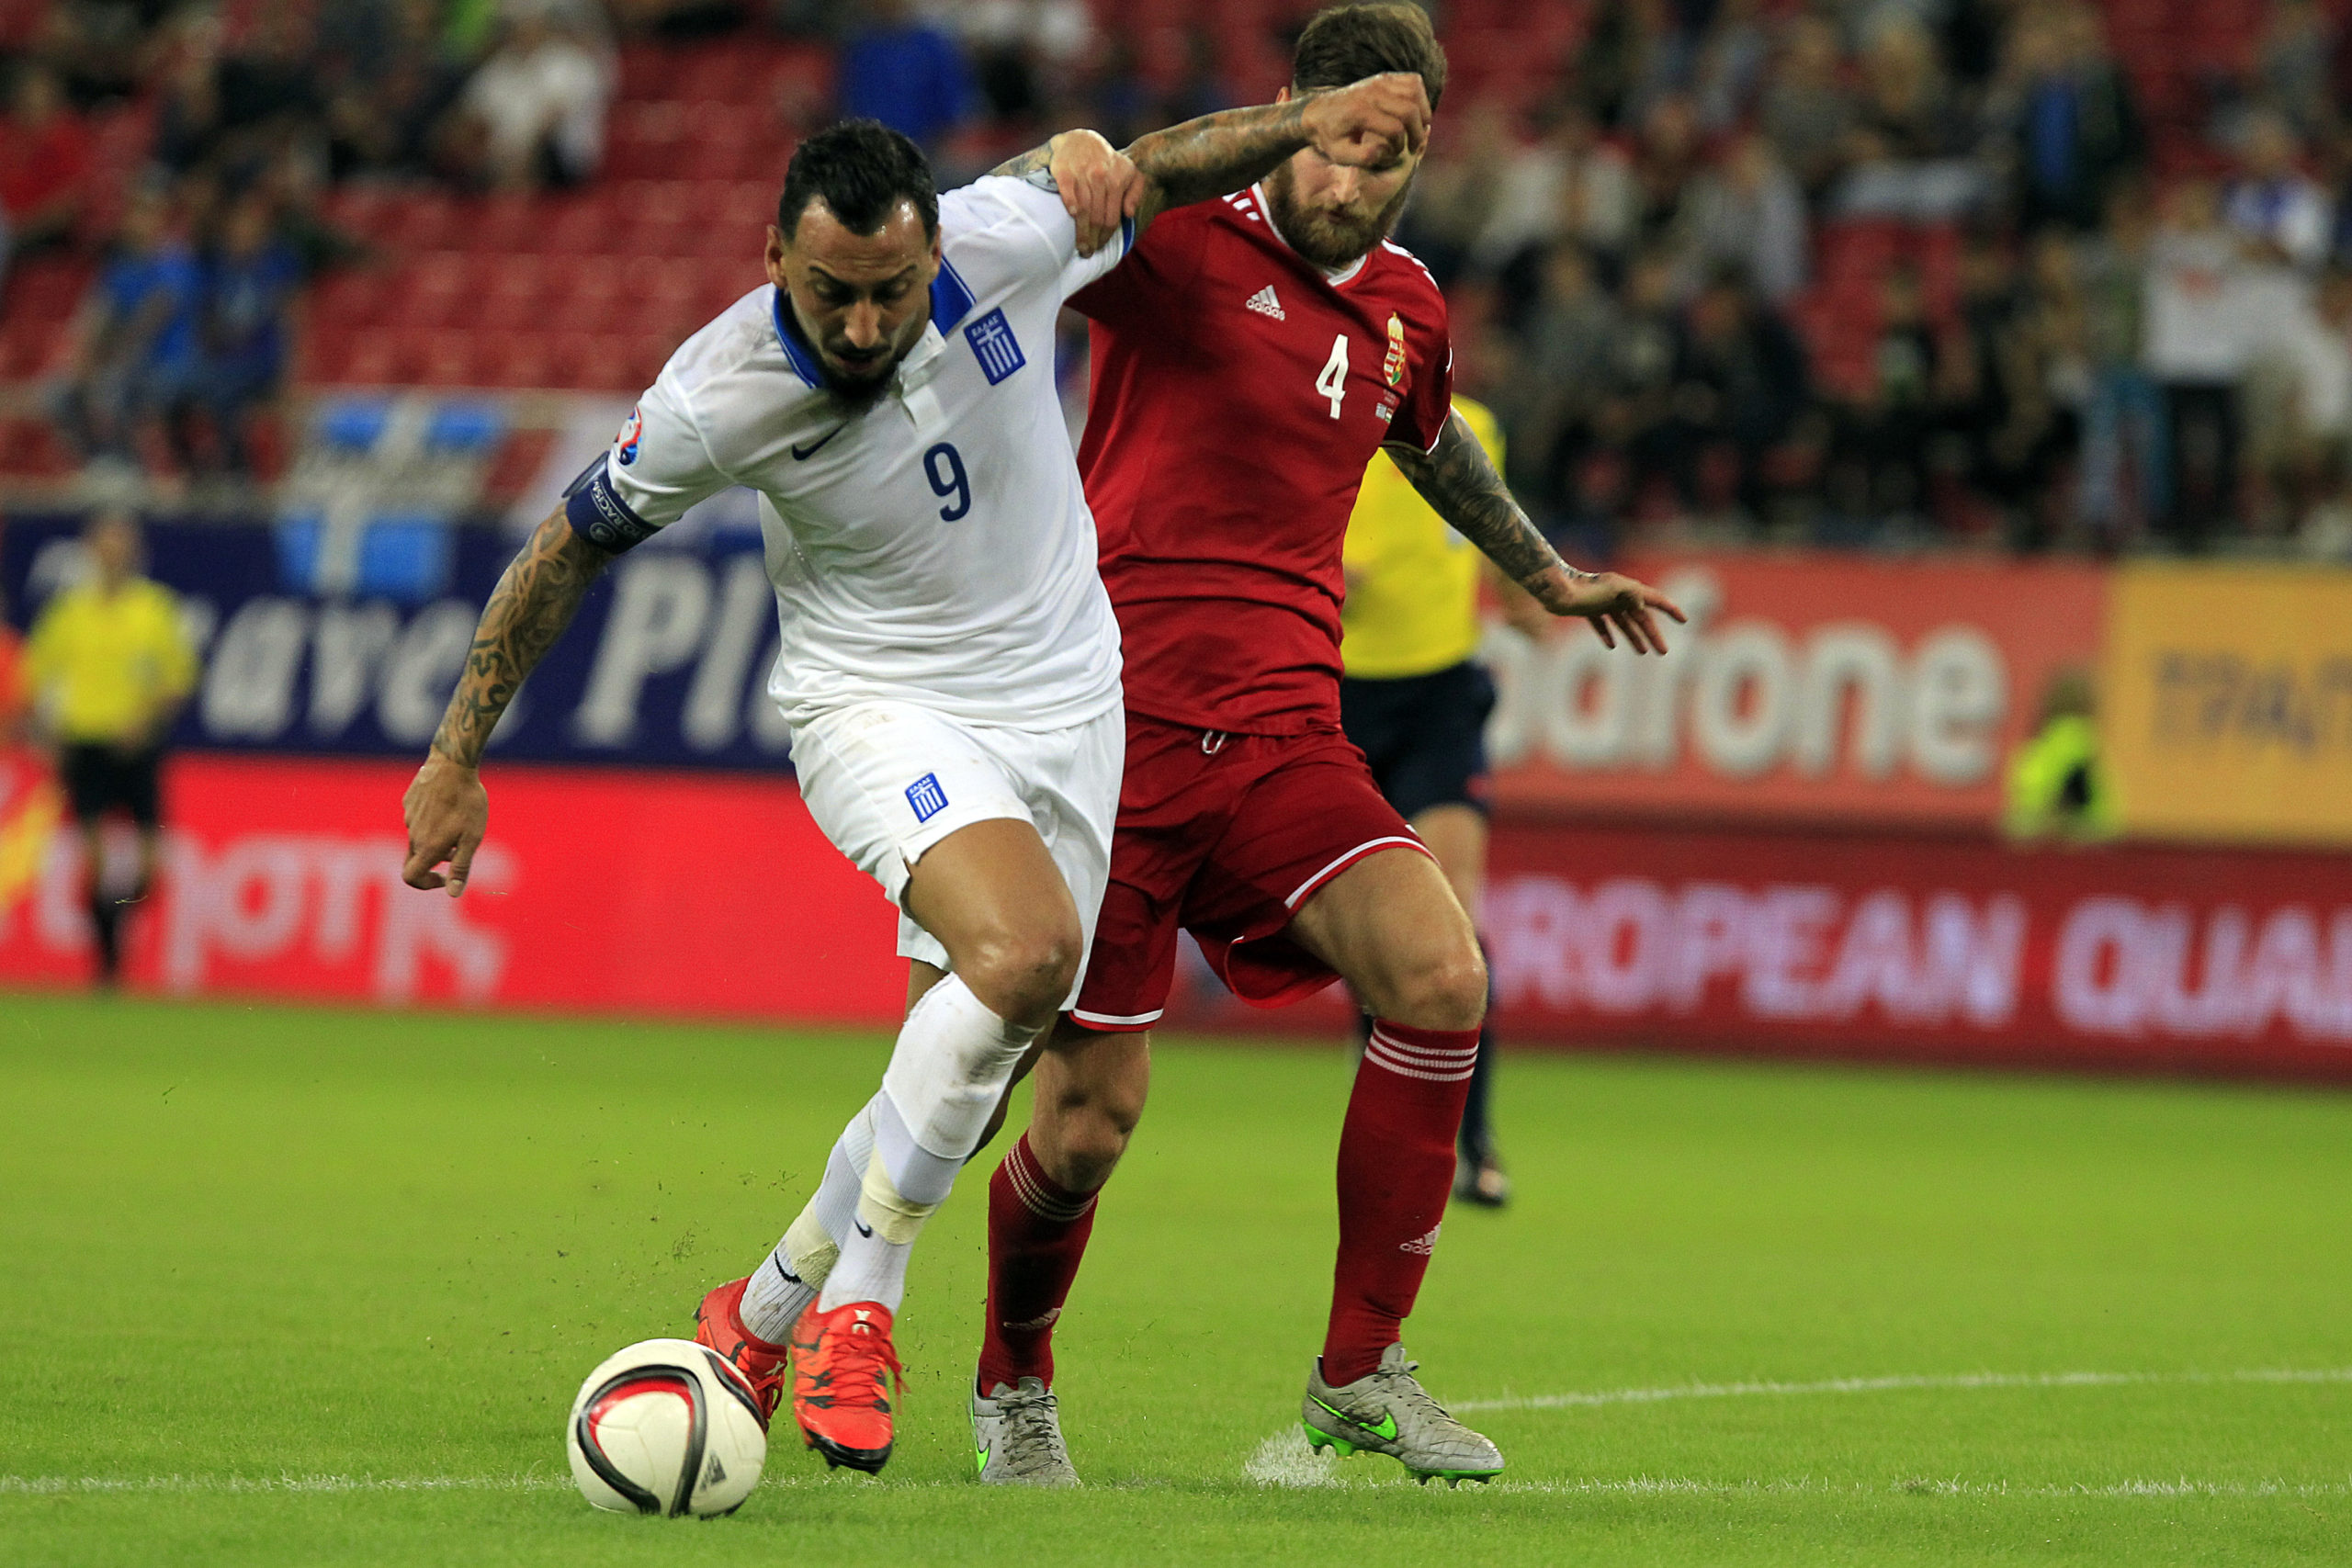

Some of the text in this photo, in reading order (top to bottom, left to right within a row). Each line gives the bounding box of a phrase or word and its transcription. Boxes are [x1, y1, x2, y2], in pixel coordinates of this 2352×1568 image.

[1246, 299, 1285, 321] adidas
[1316, 333, 1349, 420] 4
[923, 443, 971, 522] 9
[1481, 876, 2024, 1028] ROPEAN
